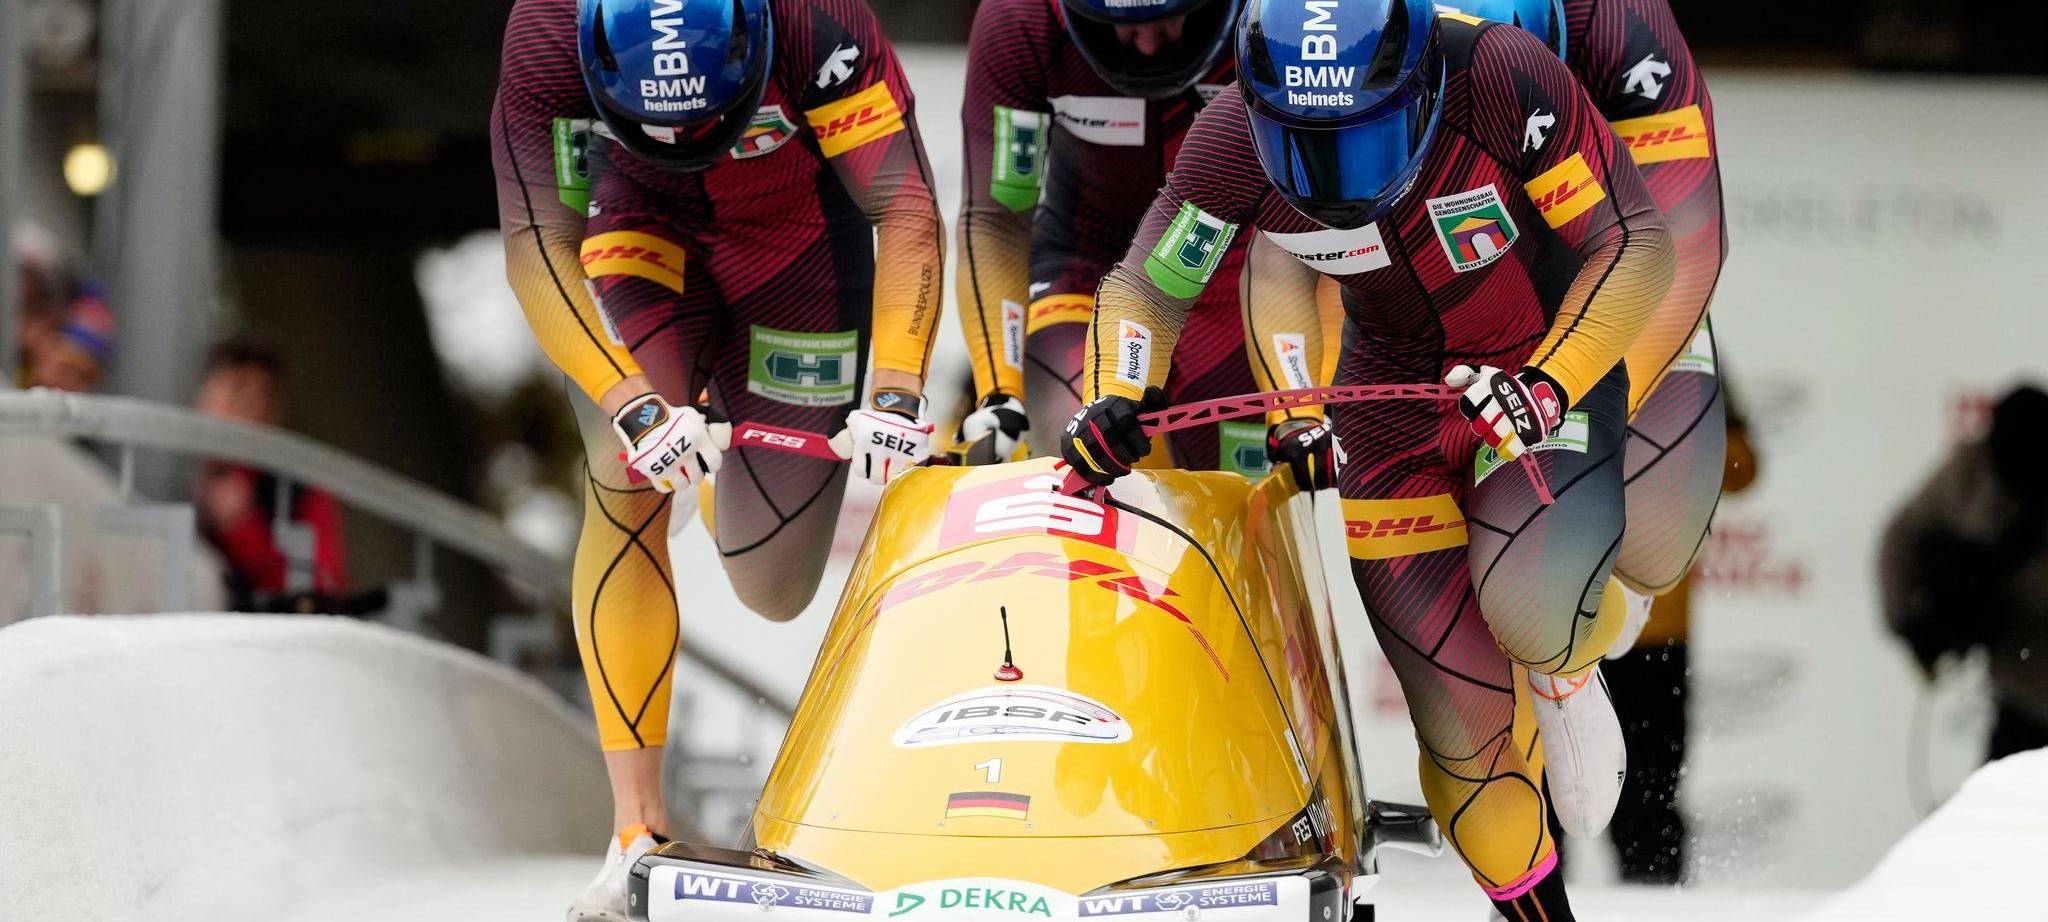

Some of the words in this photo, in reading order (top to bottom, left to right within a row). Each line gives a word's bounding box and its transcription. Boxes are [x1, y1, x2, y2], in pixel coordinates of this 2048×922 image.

[640, 75, 706, 98] BMW
[1285, 65, 1355, 88] BMW
[644, 97, 707, 112] helmets
[1288, 90, 1354, 106] helmets
[1432, 203, 1444, 211] DIE
[1444, 190, 1494, 209] WOHNUNGSBAU
[1434, 196, 1496, 217] GENOSSENSCHAFTEN
[1498, 381, 1532, 434] SEIZ
[742, 429, 807, 449] FES
[1345, 505, 1445, 539] DHL
[937, 705, 1092, 725] IBSF
[974, 757, 1003, 783] 1
[682, 874, 748, 899] WT
[799, 888, 867, 903] ENERGIE
[1202, 883, 1268, 897] ENERGIE
[794, 896, 866, 911] SYSTEME
[940, 887, 1052, 917] DEKRA
[1084, 896, 1149, 914] WT
[1199, 892, 1271, 906] SYSTEME
